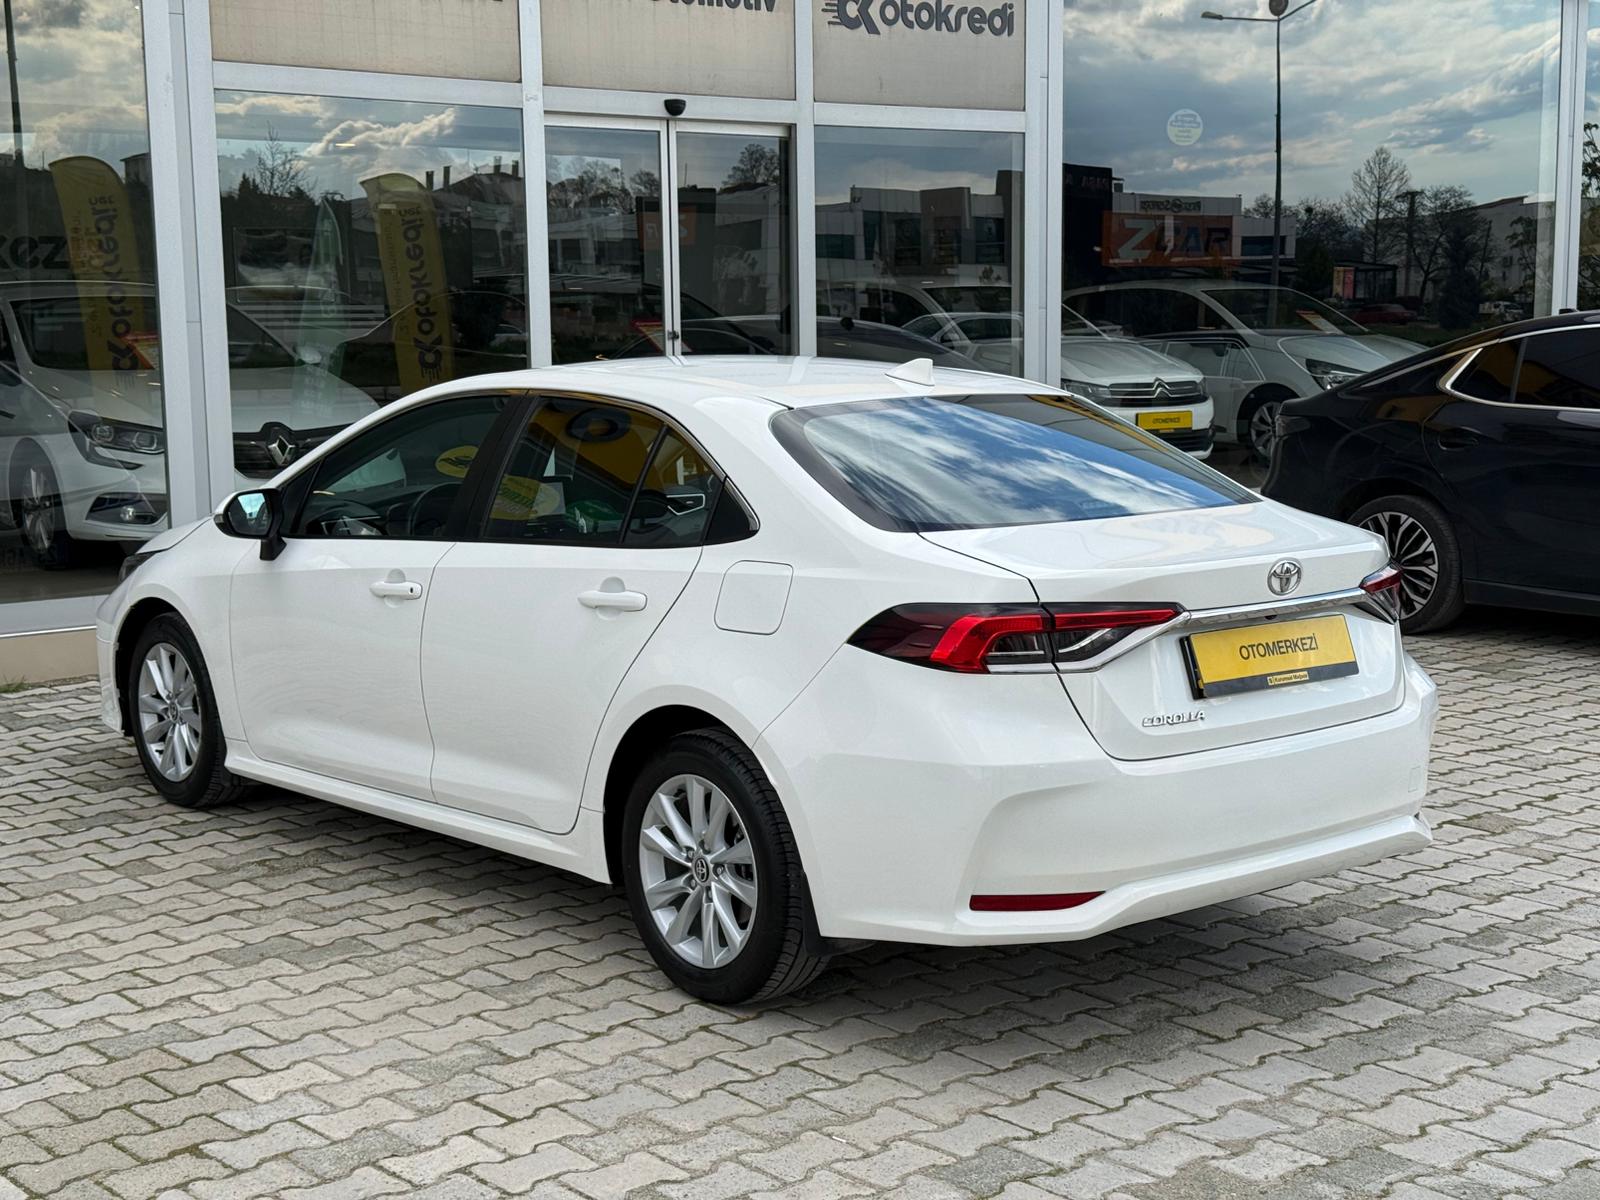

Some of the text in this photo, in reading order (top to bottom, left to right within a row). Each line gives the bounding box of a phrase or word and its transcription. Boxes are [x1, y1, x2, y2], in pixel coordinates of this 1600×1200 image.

[879, 2, 1014, 37] otokredi
[1239, 633, 1318, 660] OTOMERKEZİ
[1142, 710, 1206, 727] COROLLA
